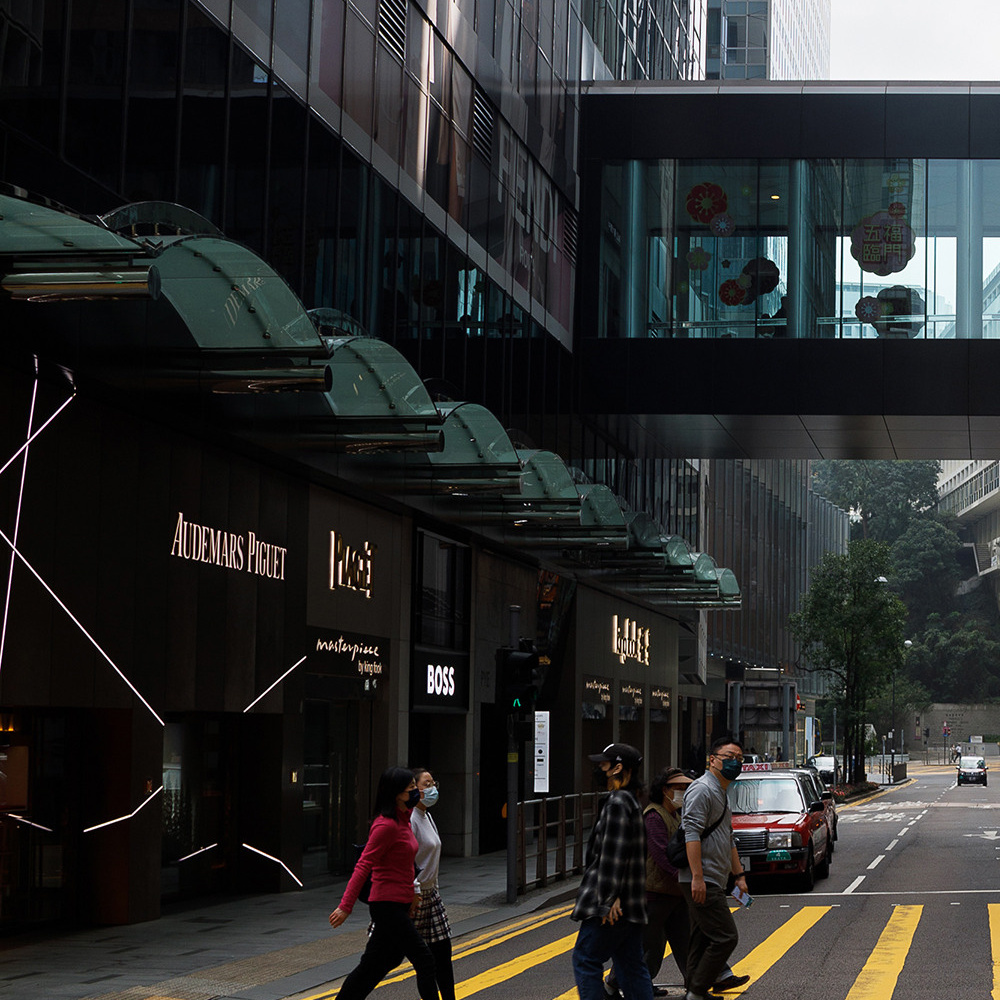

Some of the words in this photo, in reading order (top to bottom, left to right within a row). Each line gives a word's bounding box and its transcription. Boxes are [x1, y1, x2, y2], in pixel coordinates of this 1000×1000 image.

[863, 225, 903, 244] 五福
[863, 243, 903, 264] 臨門
[170, 511, 244, 571] AUDEMARS
[246, 530, 288, 581] PIGUET
[316, 634, 380, 662] masterpiece
[426, 663, 456, 696] BOSS
[741, 763, 769, 771] TAXI
